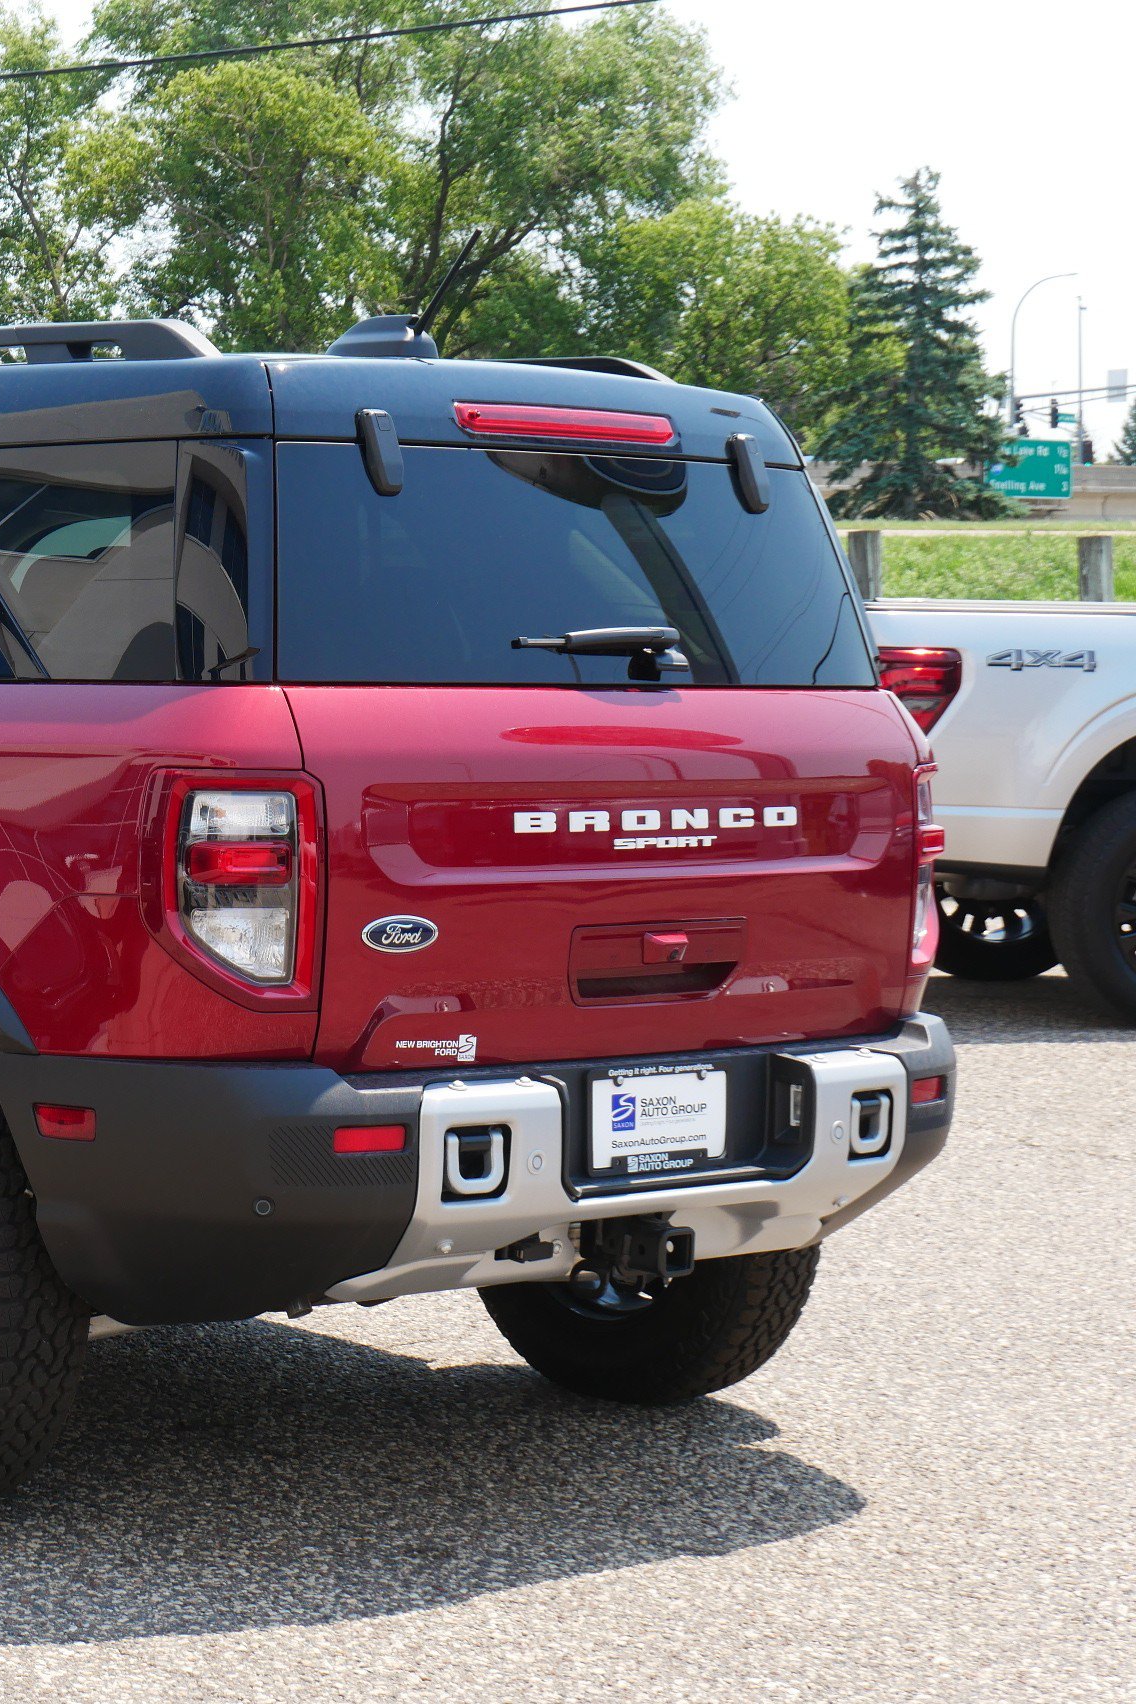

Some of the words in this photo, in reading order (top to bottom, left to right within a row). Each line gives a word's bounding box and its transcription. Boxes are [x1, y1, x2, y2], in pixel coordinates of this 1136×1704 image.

[1029, 480, 1047, 492] Ave
[513, 806, 798, 834] BRONCO
[613, 836, 718, 850] SPORT
[381, 923, 423, 944] Ford
[395, 1040, 416, 1049] NEW
[416, 1040, 459, 1048] BRIGHTON
[434, 1048, 458, 1056] FORD
[608, 1068, 634, 1077] Getting
[658, 1065, 674, 1073] Four
[640, 1096, 677, 1108] SAXON
[640, 1106, 669, 1118] AUTO
[670, 1103, 707, 1115] GROUP
[613, 1121, 634, 1129] SAXON
[611, 1134, 707, 1149] SaxonAutoGroup.com
[639, 1153, 669, 1163] SAXON
[639, 1161, 662, 1172] AUTO
[662, 1158, 694, 1170] GROUP
